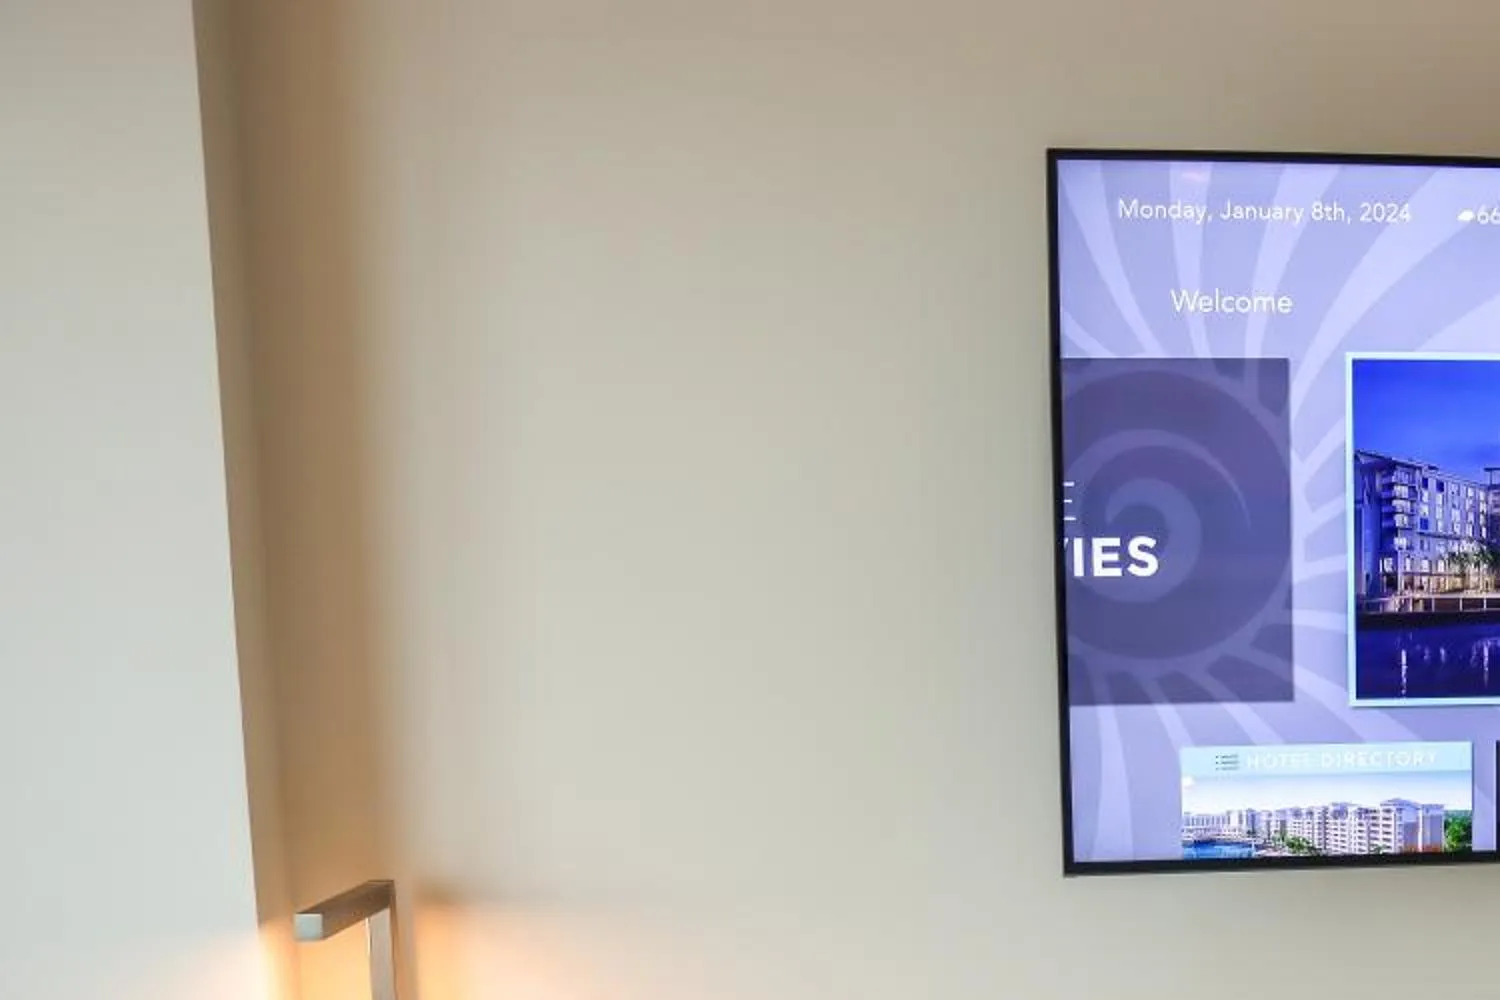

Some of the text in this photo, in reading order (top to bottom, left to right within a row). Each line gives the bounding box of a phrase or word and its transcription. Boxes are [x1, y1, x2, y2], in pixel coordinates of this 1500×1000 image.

[1118, 199, 1411, 226] Monday, January 8th, 2024
[1170, 288, 1293, 315] Welcome
[1063, 536, 1159, 577] IES
[1247, 750, 1438, 769] HOTEL DIRECTORY
